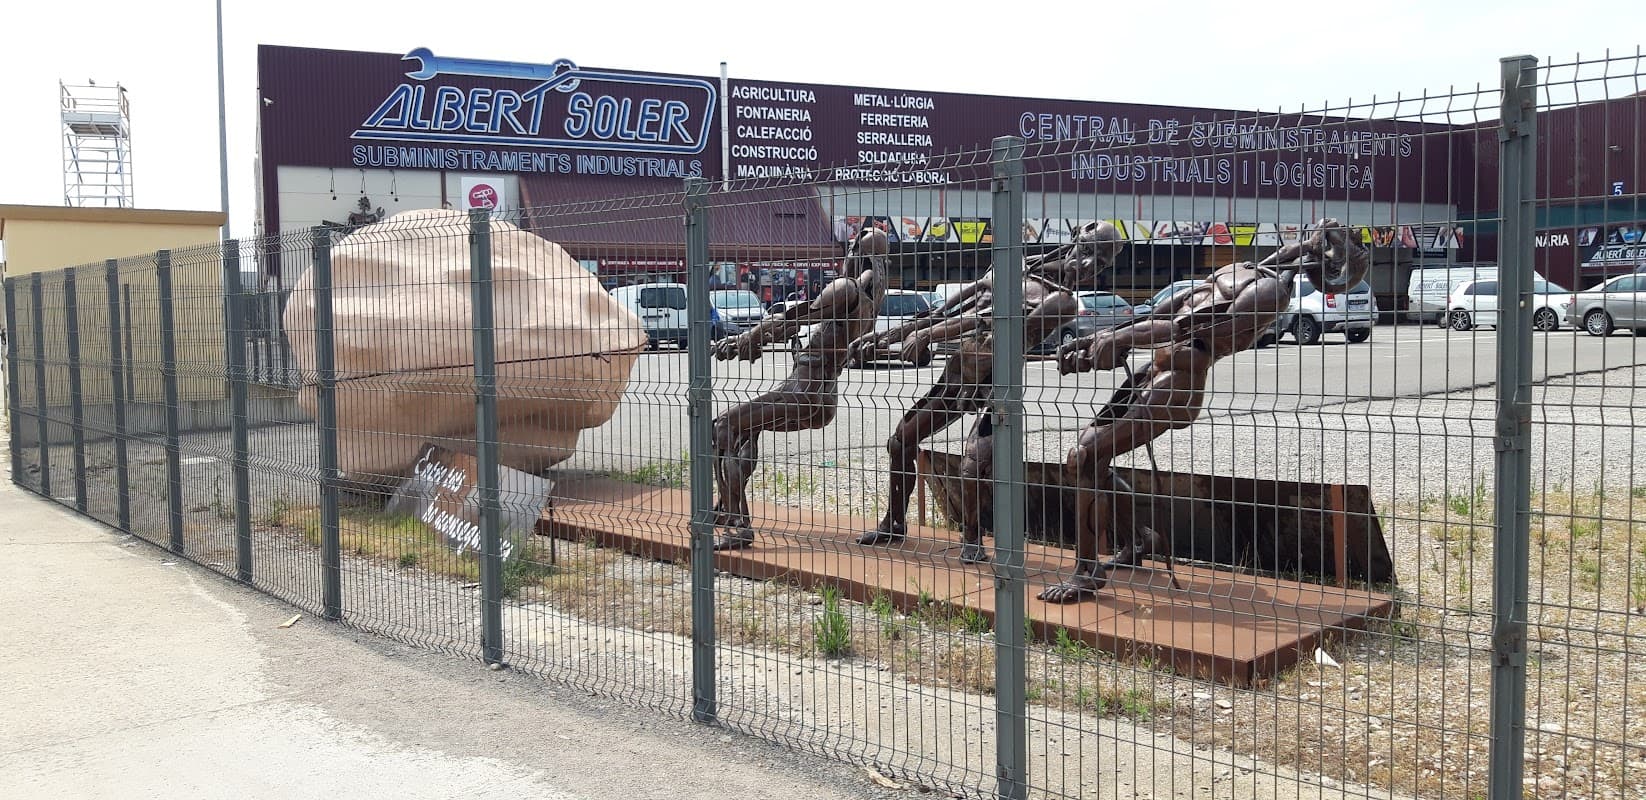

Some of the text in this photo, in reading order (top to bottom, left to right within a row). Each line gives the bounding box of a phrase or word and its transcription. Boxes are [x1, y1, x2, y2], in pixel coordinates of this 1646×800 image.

[732, 86, 816, 103] AGRICULTURA
[854, 93, 934, 110] METAL·LÚRGIA
[362, 84, 695, 144] ALBERT SOLER
[736, 106, 811, 122] FONTANERIA
[861, 112, 928, 128] FERRETERIA
[737, 125, 812, 142] CALEFACCIÓ
[857, 132, 933, 147] SERRALLERIA
[1019, 111, 1412, 158] CENTRAL DE SUBMINISTRAMENTS
[731, 144, 817, 161] CONSTRUCCIÓ
[858, 150, 927, 165] SOLDADURA
[352, 145, 703, 179] SUBMINISTRAMENTS INDUSTRIALS
[737, 163, 813, 180] MAQUINÀRIA
[835, 168, 953, 185] PROTECCIÓ LABORAL
[1071, 153, 1376, 190] INDUSTRIALS I LOGÍSTICA
[1614, 185, 1623, 197] 5
